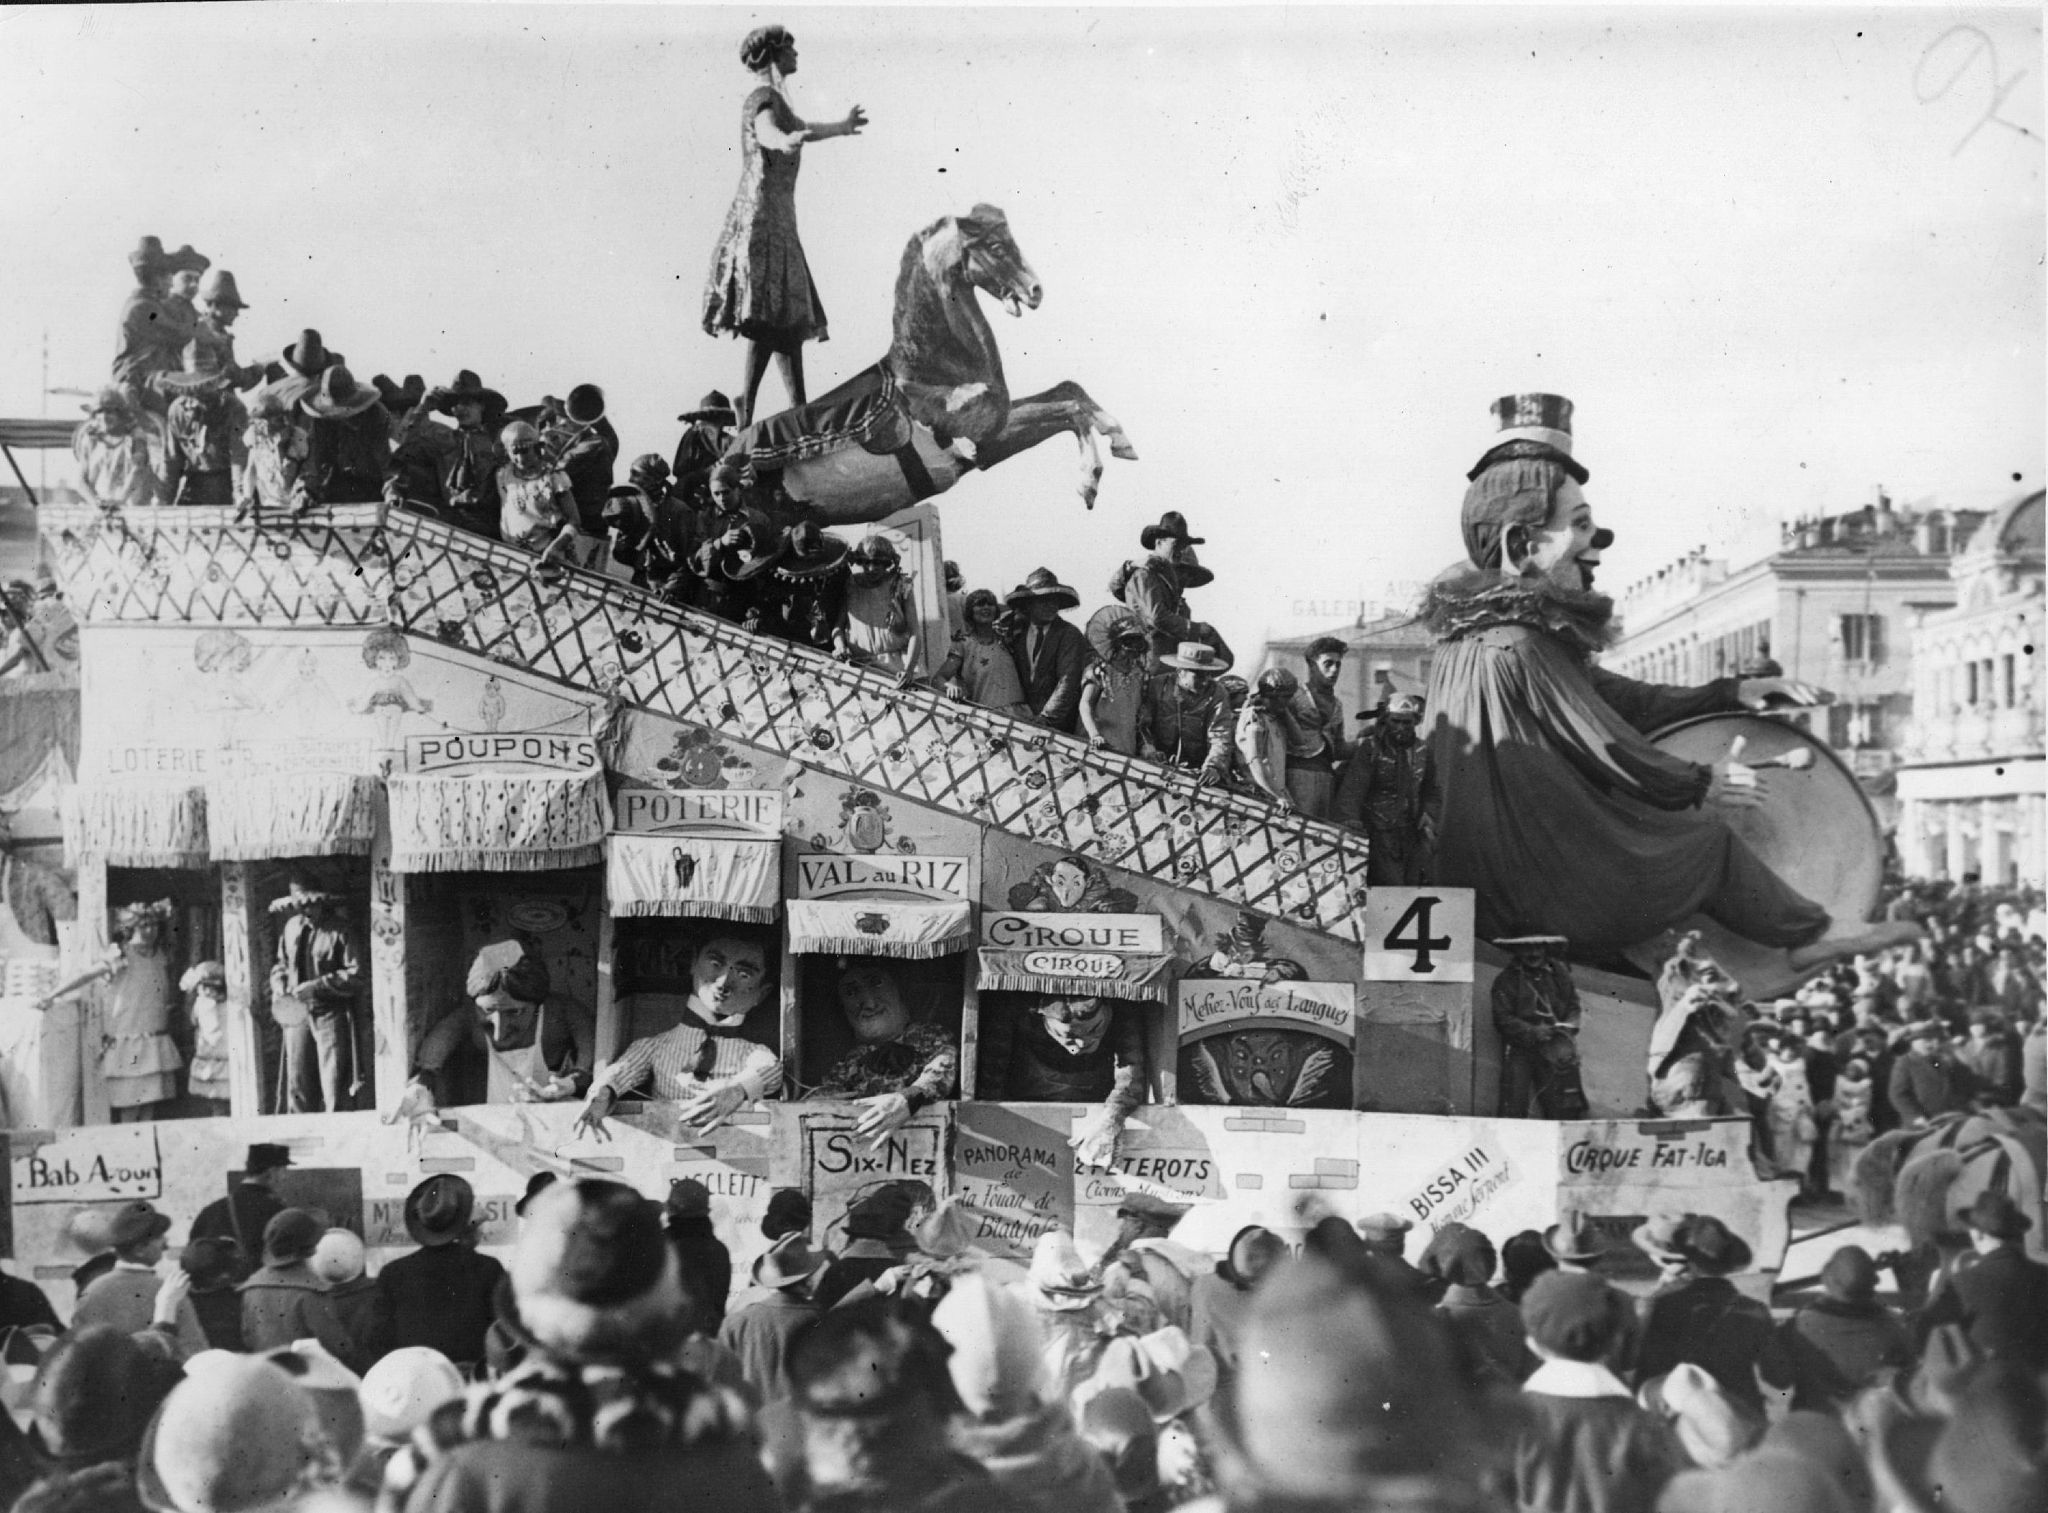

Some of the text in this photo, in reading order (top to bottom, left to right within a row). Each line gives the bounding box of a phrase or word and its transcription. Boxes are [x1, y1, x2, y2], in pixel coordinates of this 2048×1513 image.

[107, 747, 207, 774] LOTERIE
[419, 738, 596, 768] POUPONS
[627, 795, 774, 827] POTERIE
[801, 860, 964, 896] VAL au RIZ
[989, 917, 1142, 948] CIRQUE
[1383, 896, 1452, 973] 4
[1032, 956, 1116, 975] CIRQUE
[29, 1156, 80, 1188] Bab
[964, 1145, 1057, 1169] PANORAMA
[1567, 1141, 1728, 1174] CIRQUE FAT-IGA
[1003, 1168, 1023, 1179] de
[1409, 1147, 1490, 1221] BISSA III
